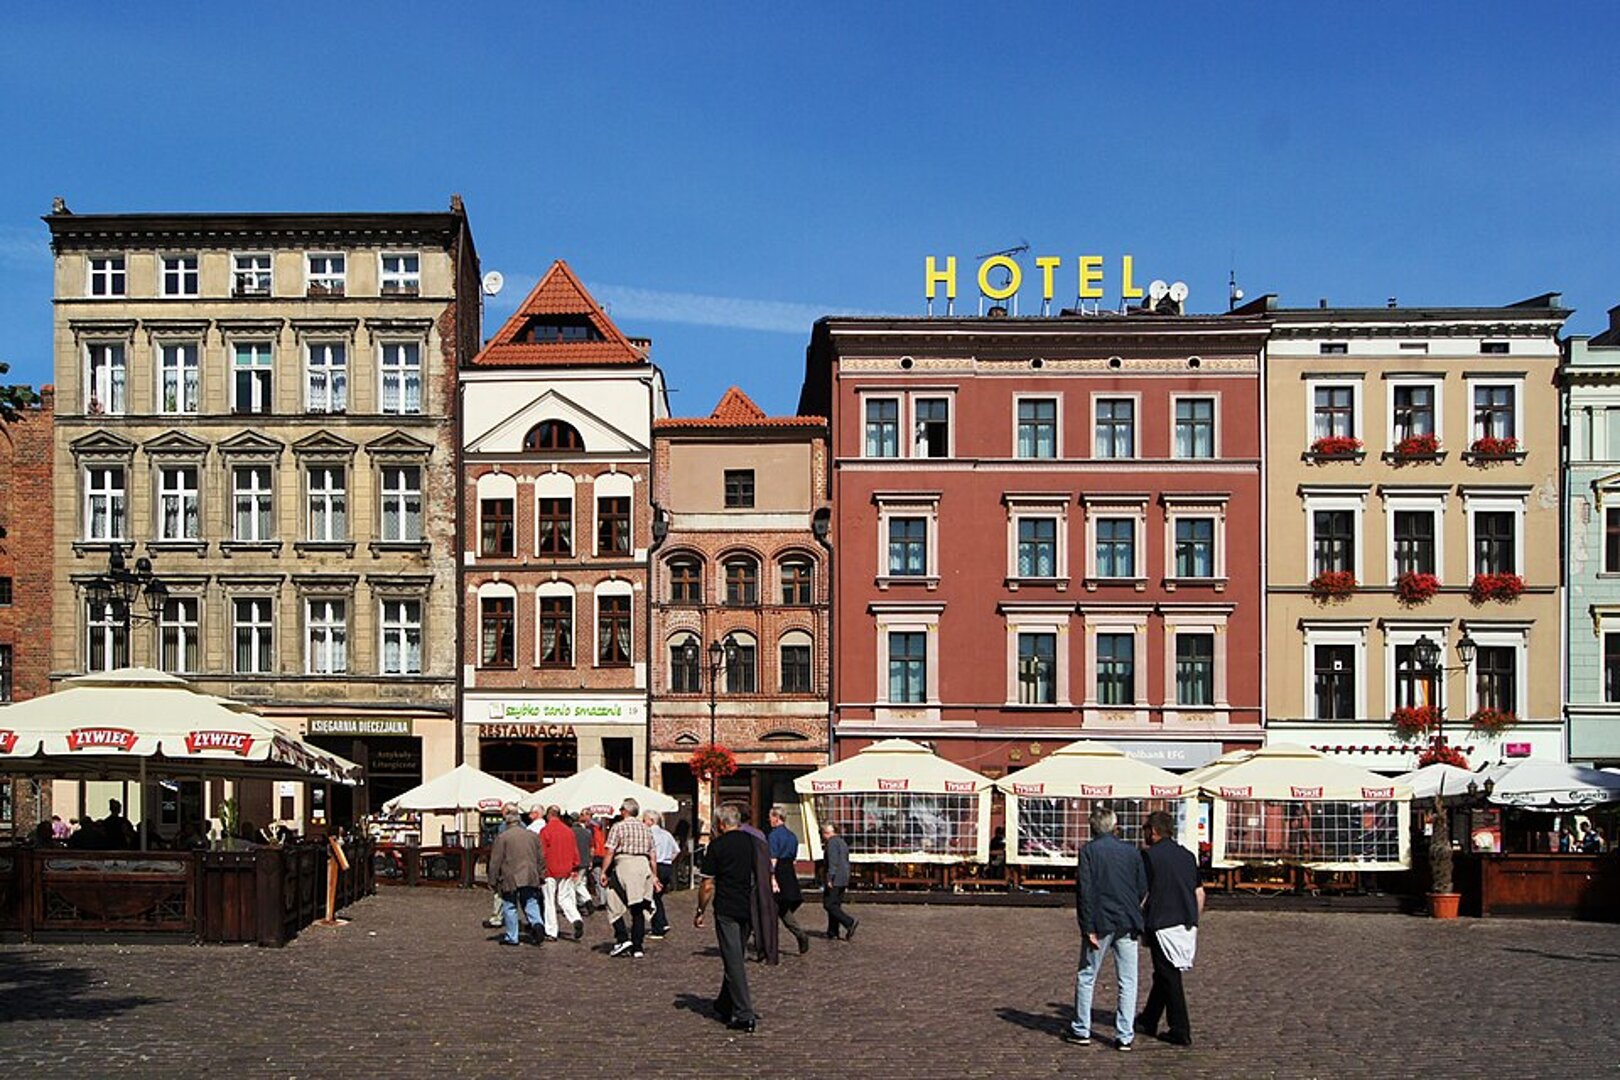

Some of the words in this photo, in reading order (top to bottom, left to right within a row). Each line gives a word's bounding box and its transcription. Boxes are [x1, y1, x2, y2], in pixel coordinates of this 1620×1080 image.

[925, 255, 1143, 300] HOTEL
[505, 703, 540, 719] szybko
[544, 704, 571, 716] tanio
[575, 704, 622, 716] smacznie
[311, 720, 357, 733] KSIĘGARNIA
[359, 721, 408, 732] DIECEZJALNA
[479, 724, 576, 737] RESTAURACJA
